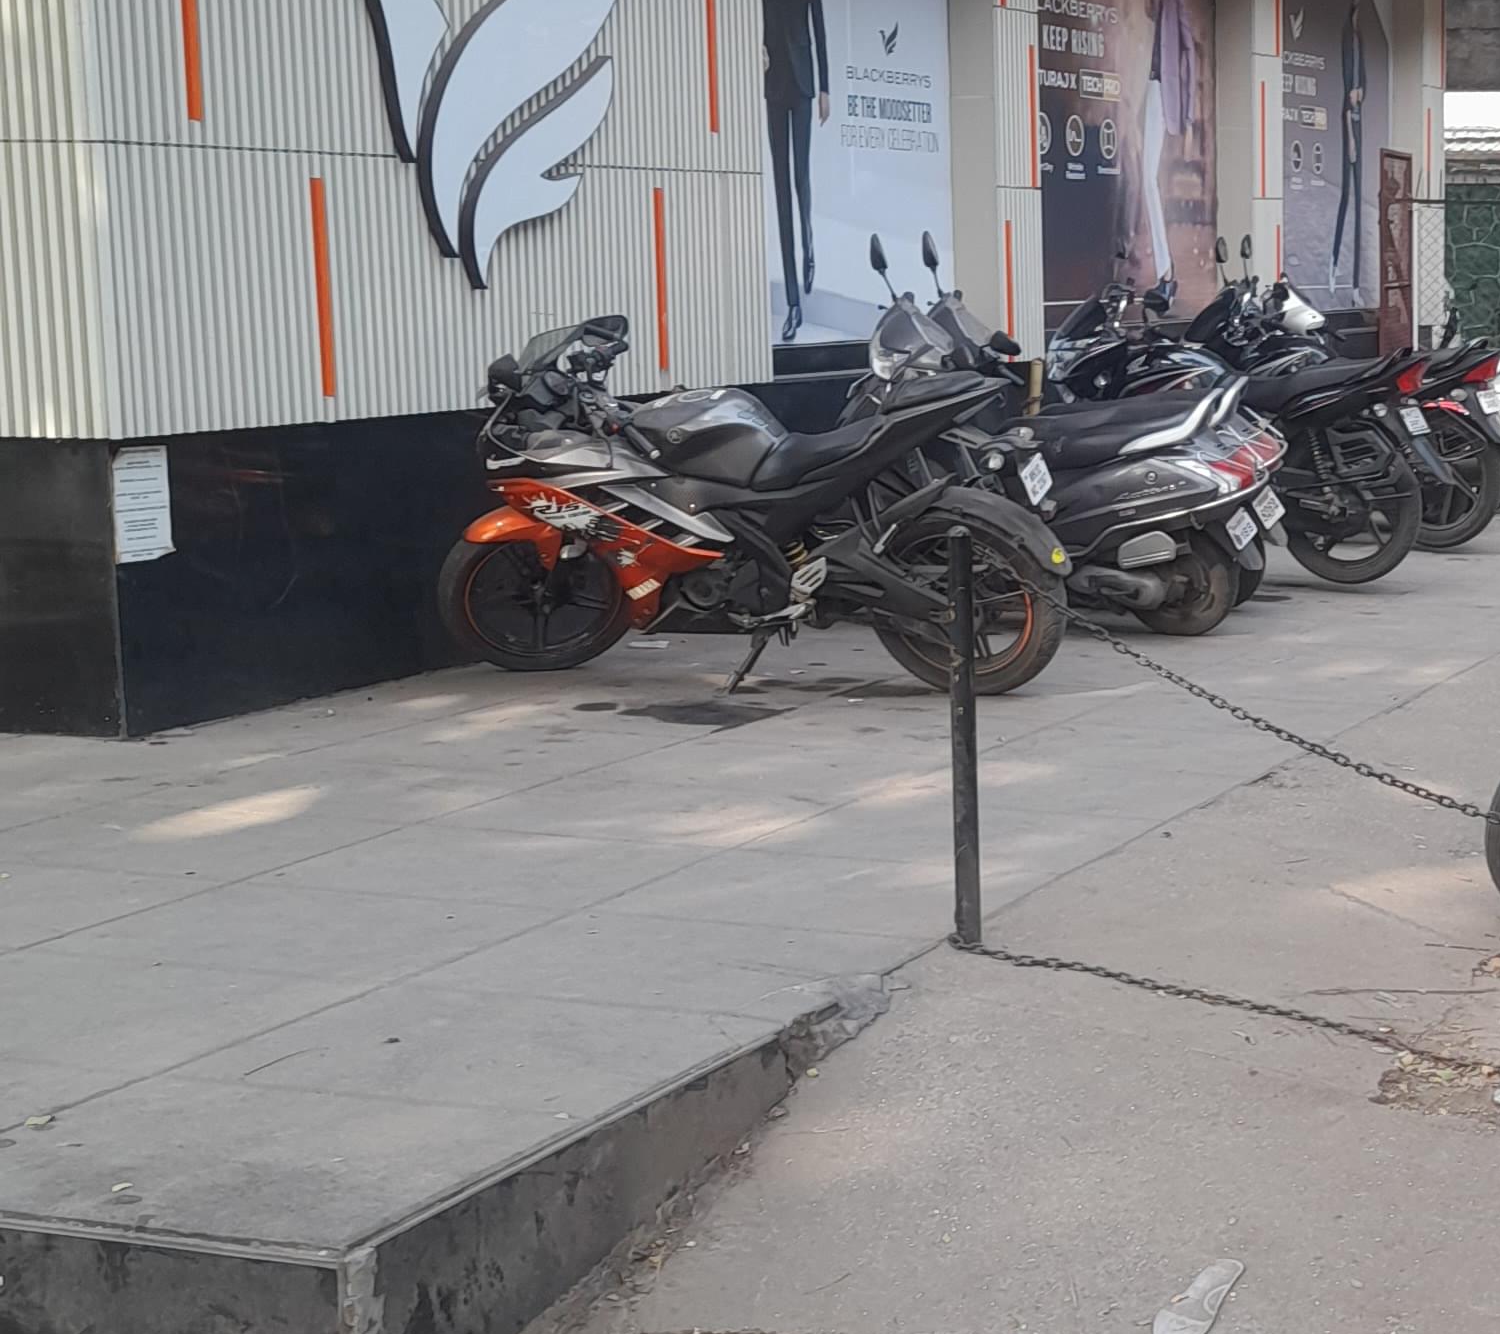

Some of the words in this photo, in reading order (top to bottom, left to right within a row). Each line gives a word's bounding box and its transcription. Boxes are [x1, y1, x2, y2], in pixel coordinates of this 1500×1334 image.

[1042, 23, 1069, 52] KEEP
[1071, 28, 1105, 58] RISING
[845, 65, 932, 89] BLACKBERRYS
[847, 94, 858, 118] BE
[860, 95, 877, 119] THE
